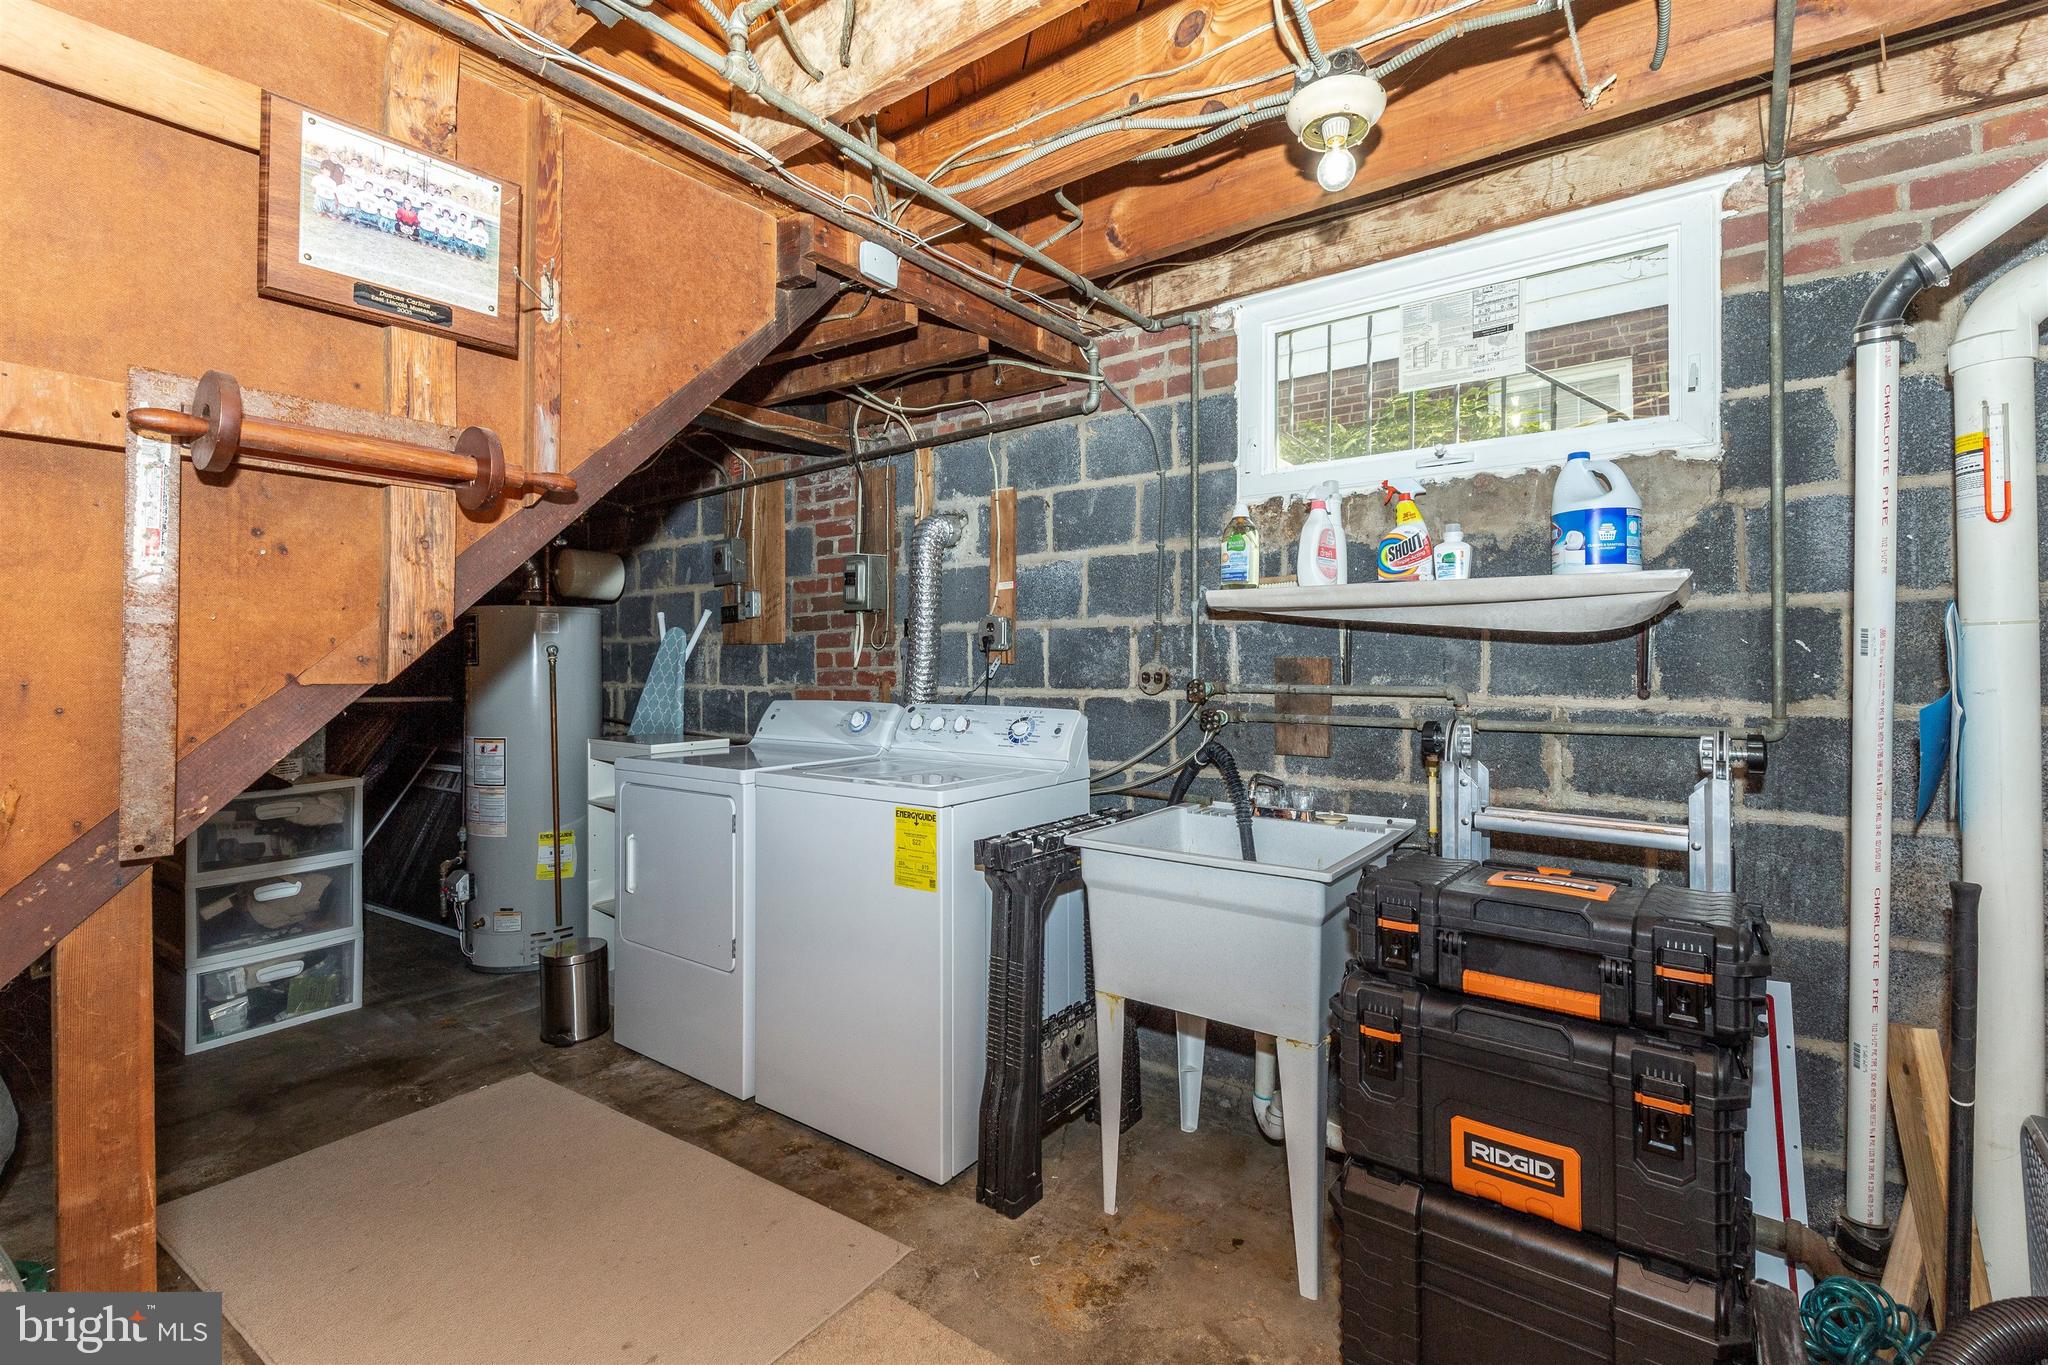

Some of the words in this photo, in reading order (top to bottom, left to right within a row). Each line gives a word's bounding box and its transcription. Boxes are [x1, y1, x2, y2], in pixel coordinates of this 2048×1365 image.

[1881, 384, 1892, 477] CHARLOTTE
[1881, 486, 1890, 527] PIPE
[1388, 533, 1423, 562] SHOUT
[896, 810, 937, 823] ENERGYGUIDE
[1872, 887, 1881, 969] CHARLOTTE
[1872, 978, 1880, 1014] PIPE
[1471, 1140, 1556, 1181] RIDGID
